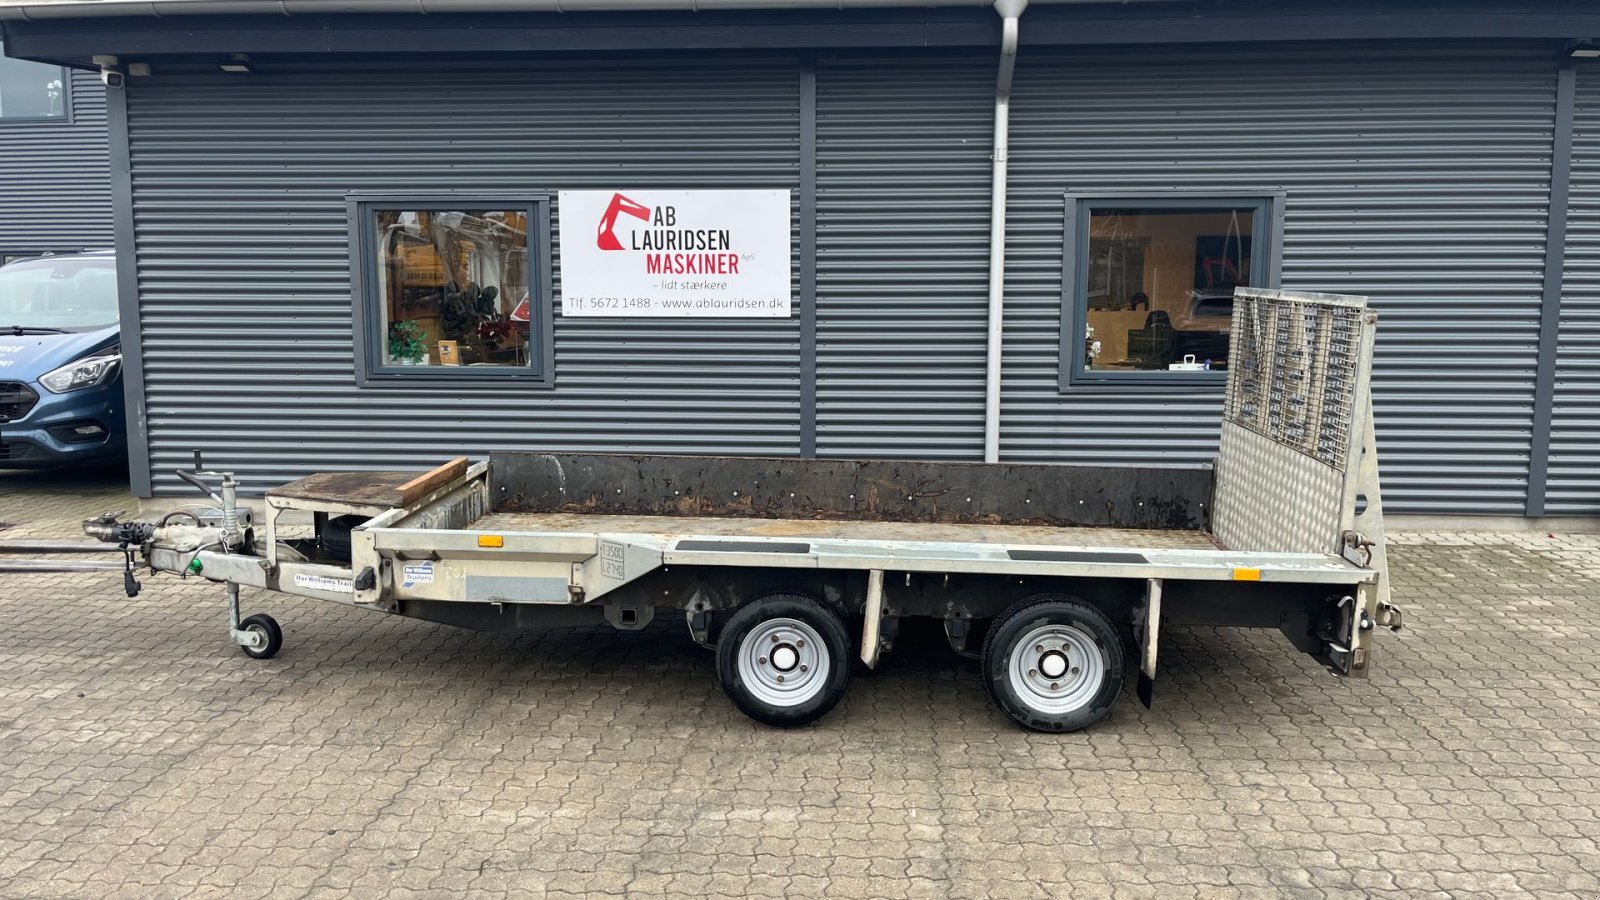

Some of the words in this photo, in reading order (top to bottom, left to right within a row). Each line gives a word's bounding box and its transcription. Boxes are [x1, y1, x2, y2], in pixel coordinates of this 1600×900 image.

[653, 205, 676, 227] AB
[631, 229, 730, 251] LAURIDSEN
[646, 253, 739, 275] MASKINER
[741, 253, 755, 262] ApS
[661, 280, 678, 290] lidt
[680, 281, 727, 290] stærkere
[569, 297, 587, 310] Tlf.
[590, 298, 619, 308] 5672
[623, 298, 651, 308] 1488
[661, 297, 784, 309] www.ablauridsen.dk
[308, 576, 336, 585] Williams
